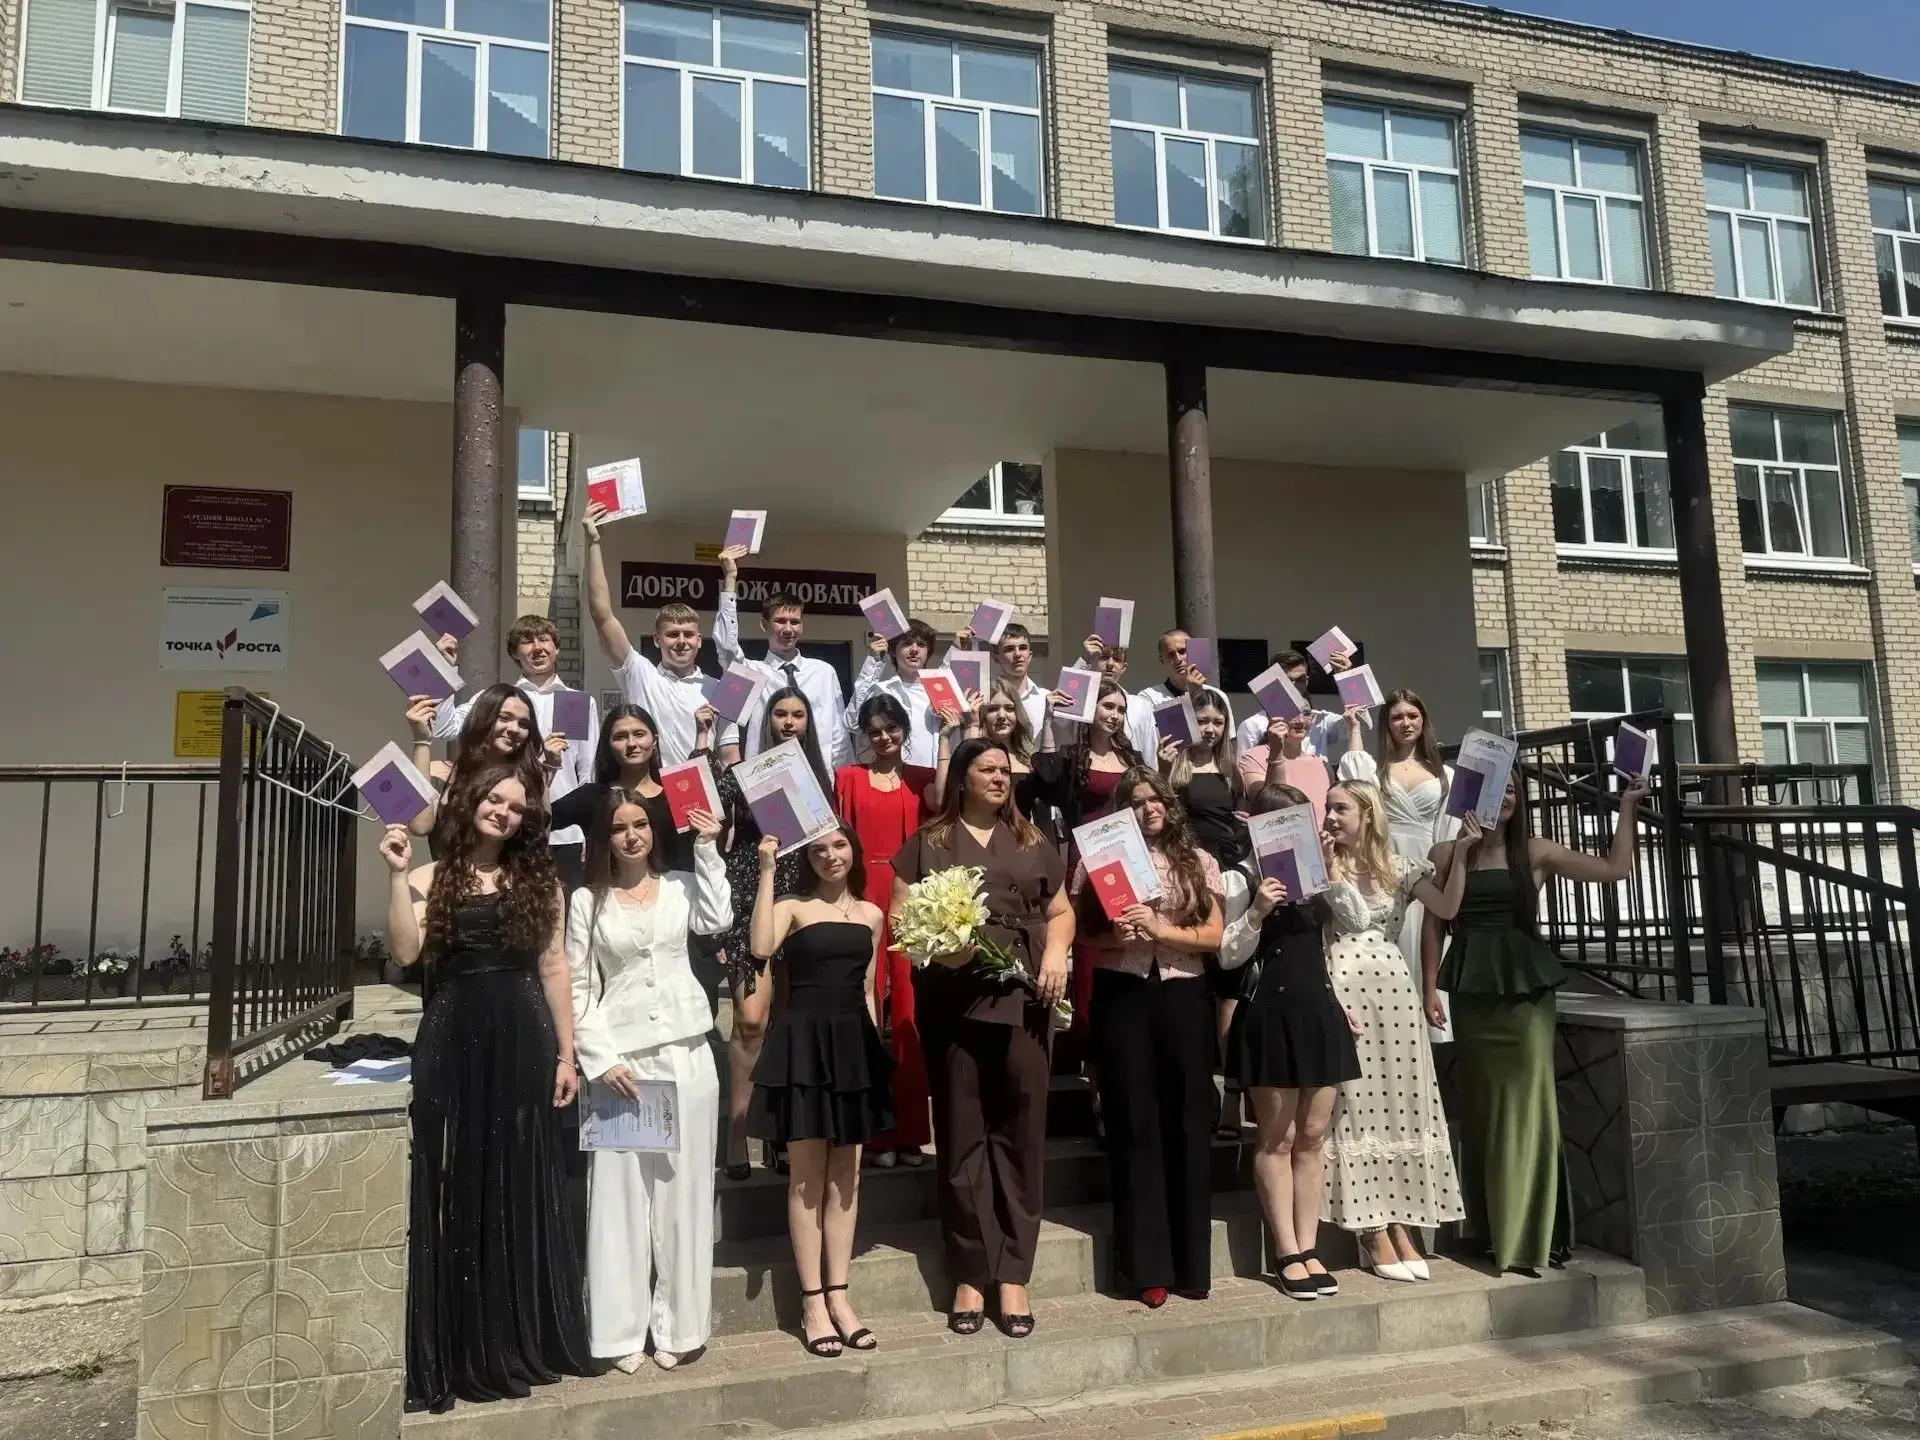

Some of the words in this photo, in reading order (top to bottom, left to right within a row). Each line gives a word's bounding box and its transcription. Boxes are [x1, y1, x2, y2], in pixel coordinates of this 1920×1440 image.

[627, 575, 704, 600] ДОБРО
[166, 641, 213, 651] ТОЧКА
[237, 643, 281, 652] РОСТА
